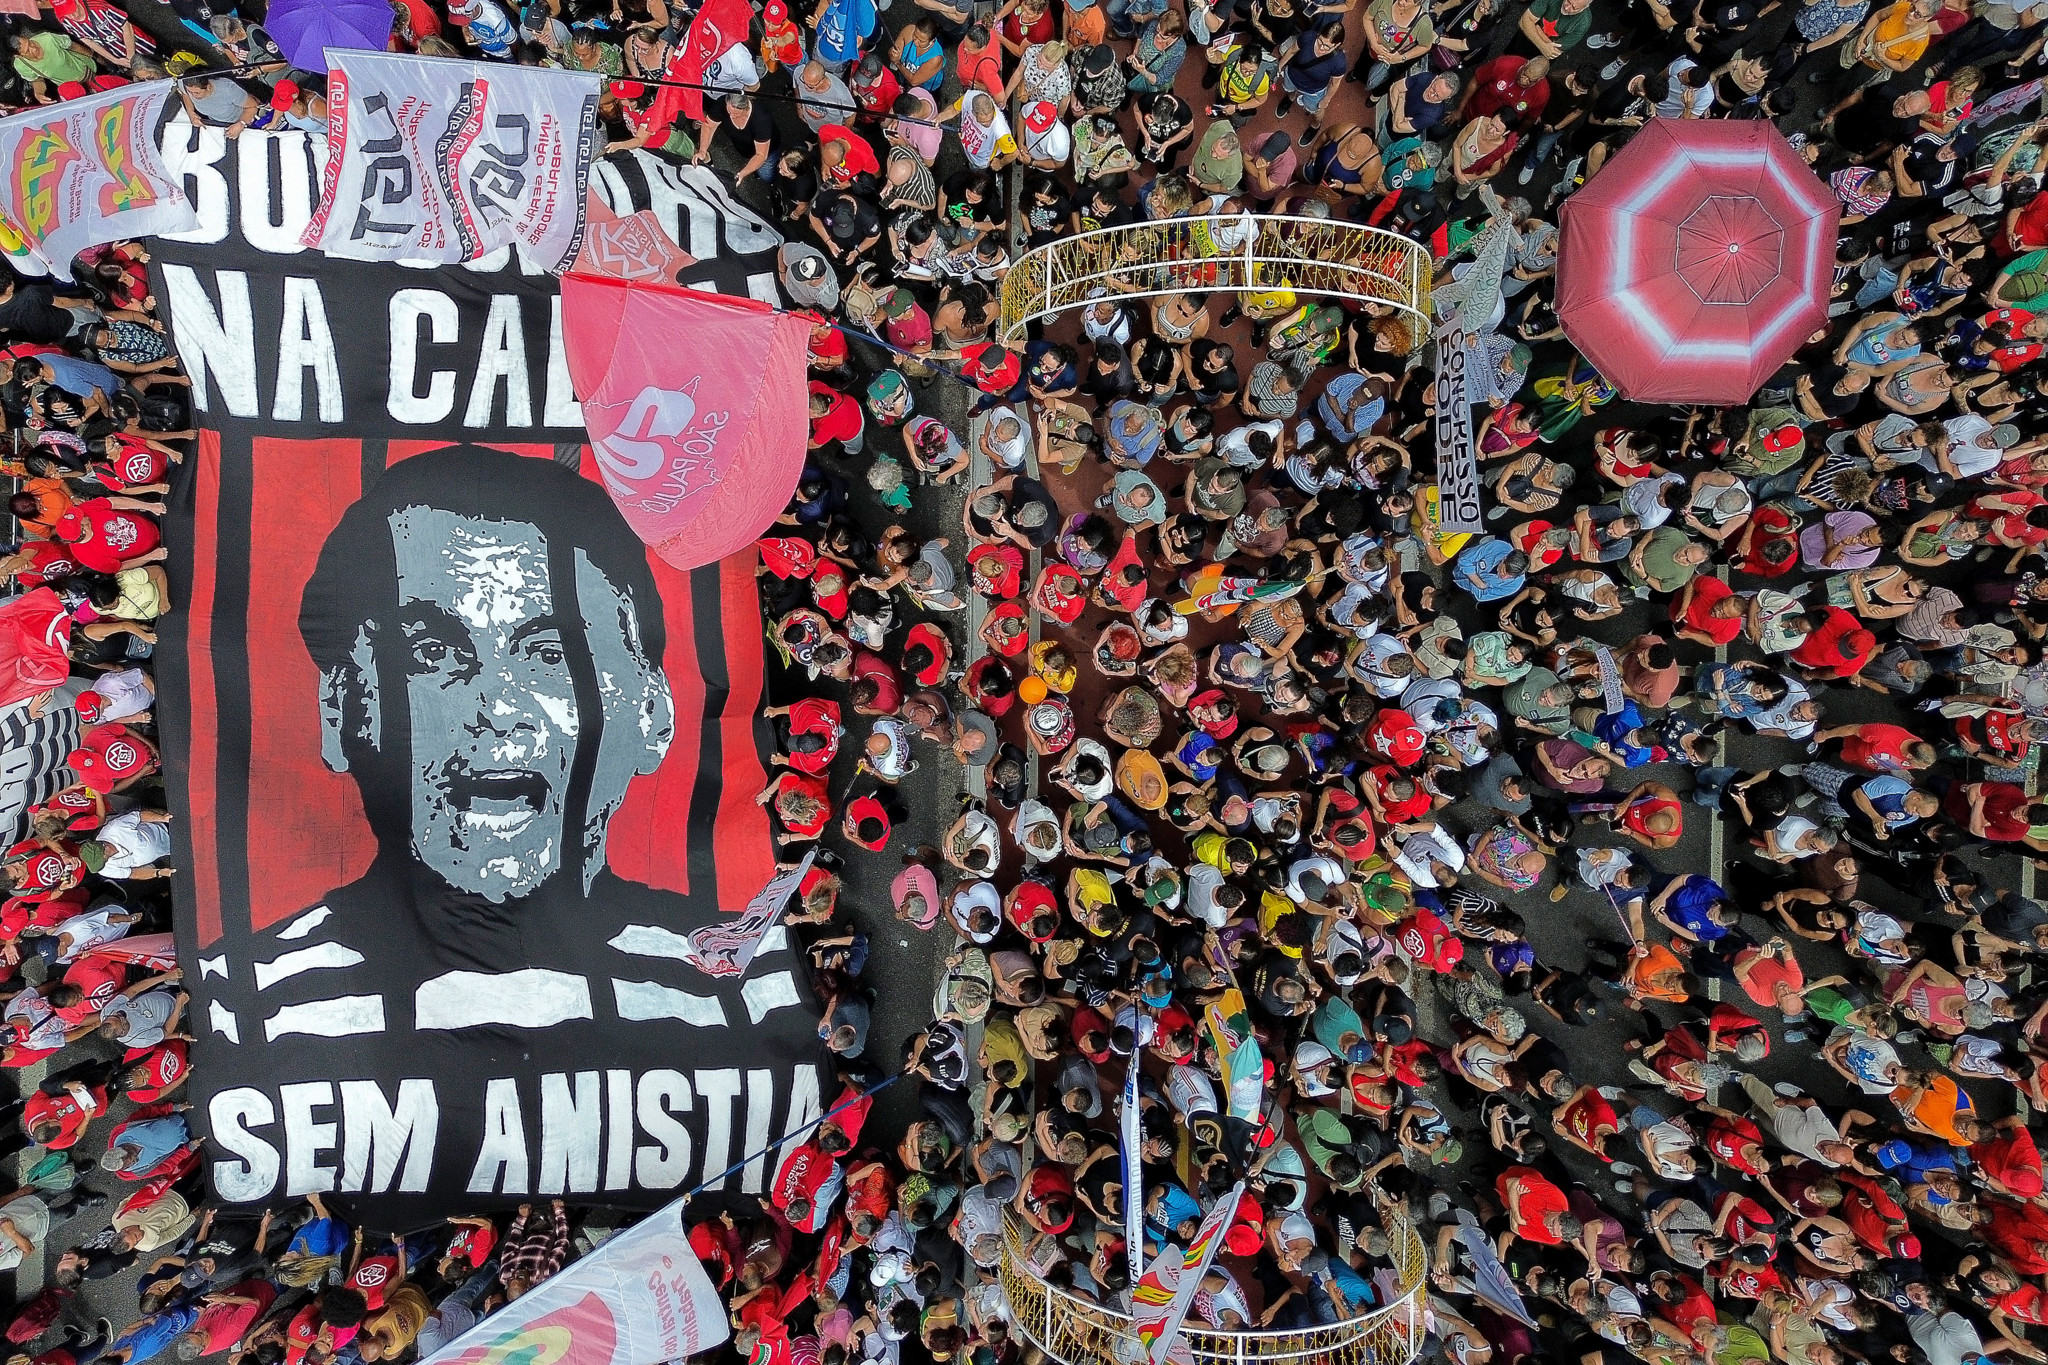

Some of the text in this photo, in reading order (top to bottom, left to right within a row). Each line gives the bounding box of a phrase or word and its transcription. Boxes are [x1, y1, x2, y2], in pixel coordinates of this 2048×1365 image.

[161, 262, 343, 423] NA
[1437, 333, 1458, 523] PODRE
[1450, 328, 1480, 523] CONGRESSO
[209, 1063, 824, 1202] SEM ANISTIA
